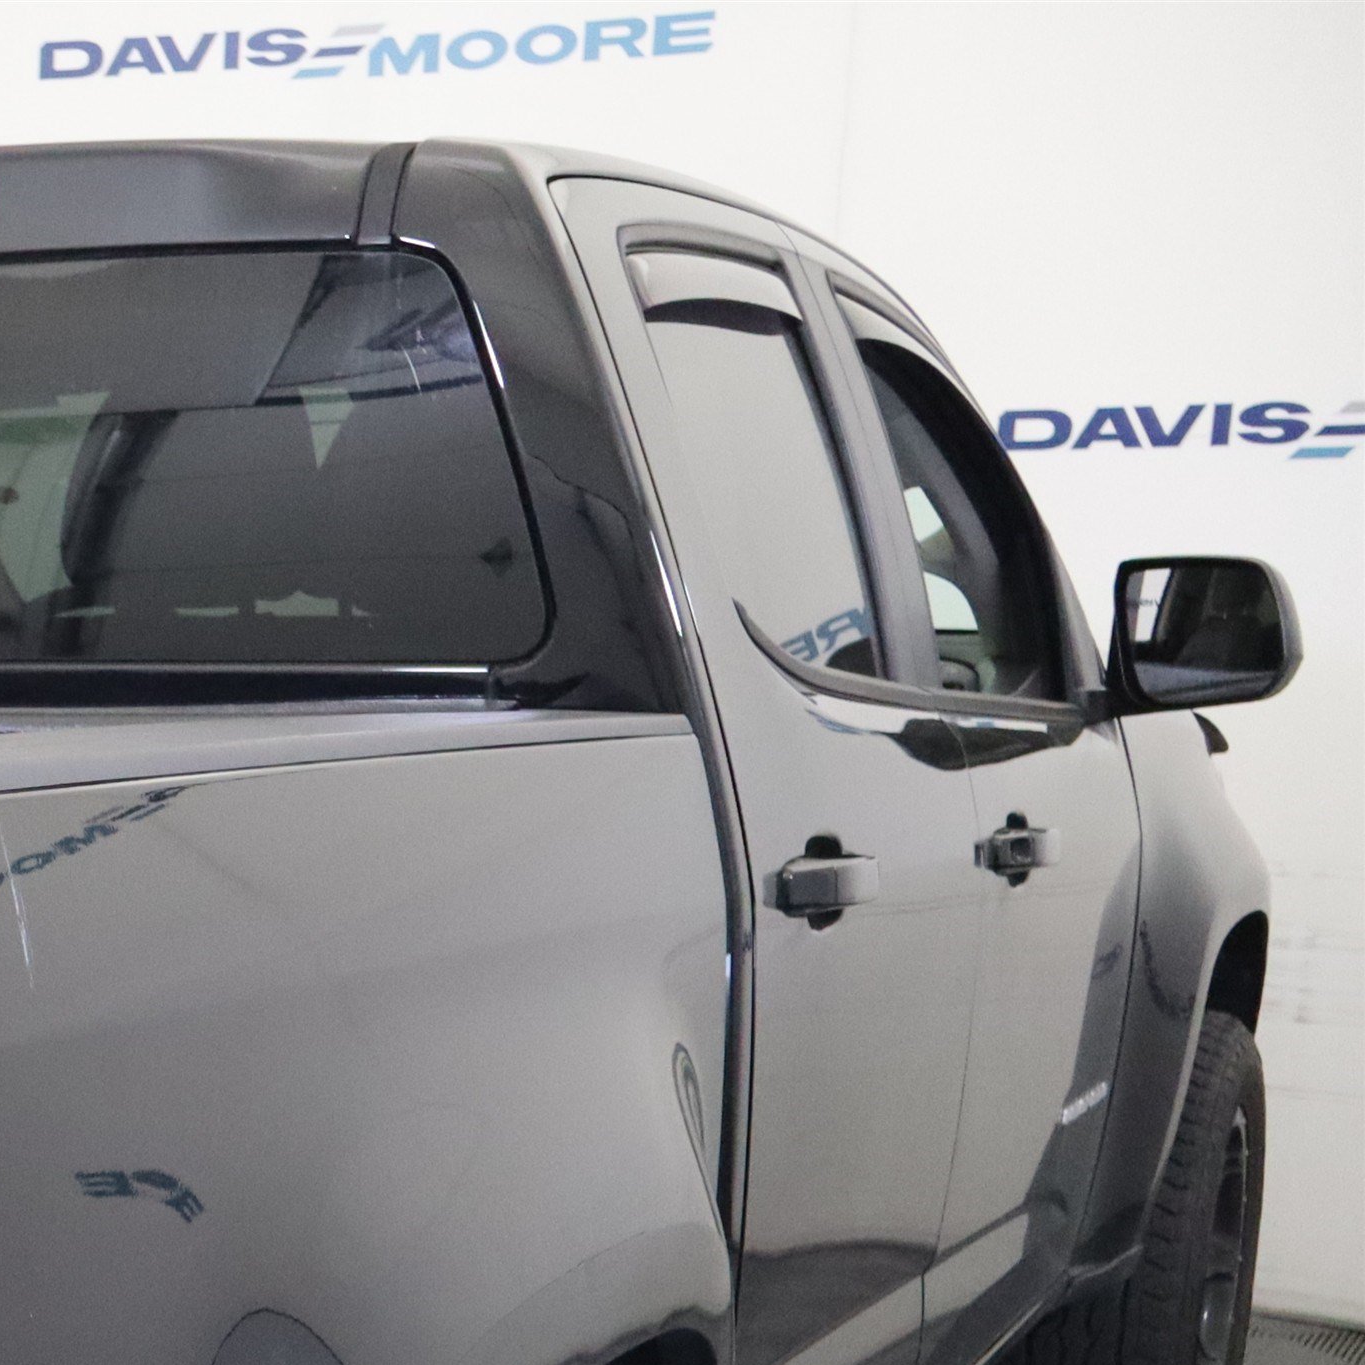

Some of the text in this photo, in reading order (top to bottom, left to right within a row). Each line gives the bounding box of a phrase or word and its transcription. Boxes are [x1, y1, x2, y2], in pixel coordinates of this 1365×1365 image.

[38, 10, 717, 81] DAVIS MOORE
[998, 401, 1312, 451] DAVIS
